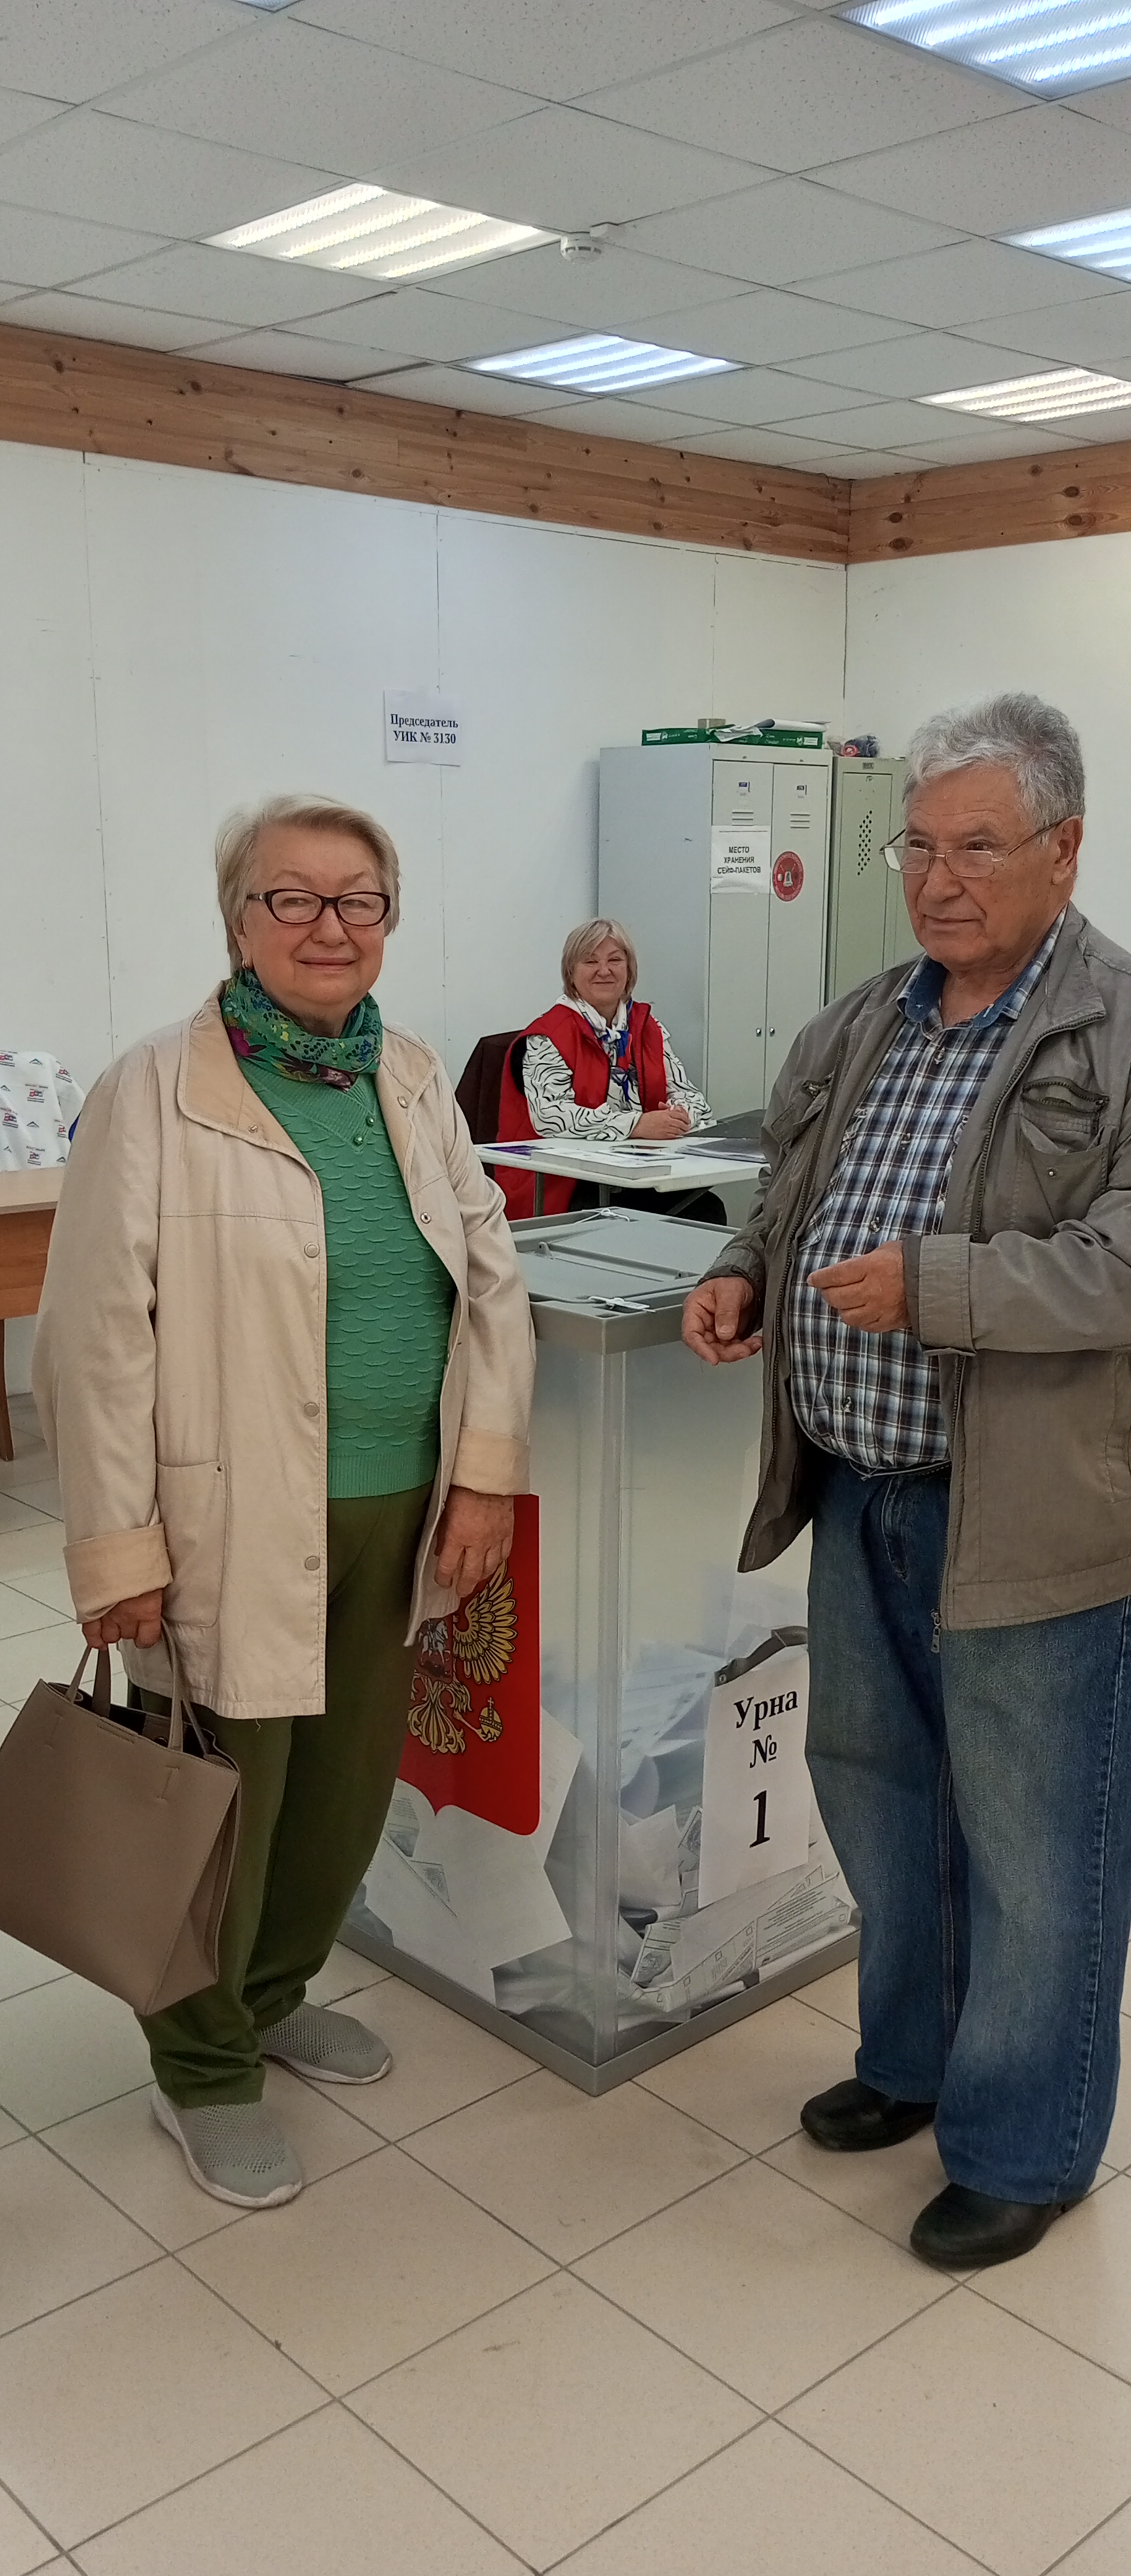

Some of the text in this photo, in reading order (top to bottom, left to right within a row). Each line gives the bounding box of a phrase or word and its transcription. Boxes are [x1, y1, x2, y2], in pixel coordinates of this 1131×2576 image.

[390, 713, 459, 728] Председатель
[393, 730, 456, 745] УИК № 3130
[728, 846, 750, 854] МЕСТО
[717, 865, 761, 874] СЕЙФ-ПАКЕТОВ
[733, 1690, 799, 1731] Урна
[749, 1734, 778, 1768] №
[749, 1789, 770, 1849] 1
